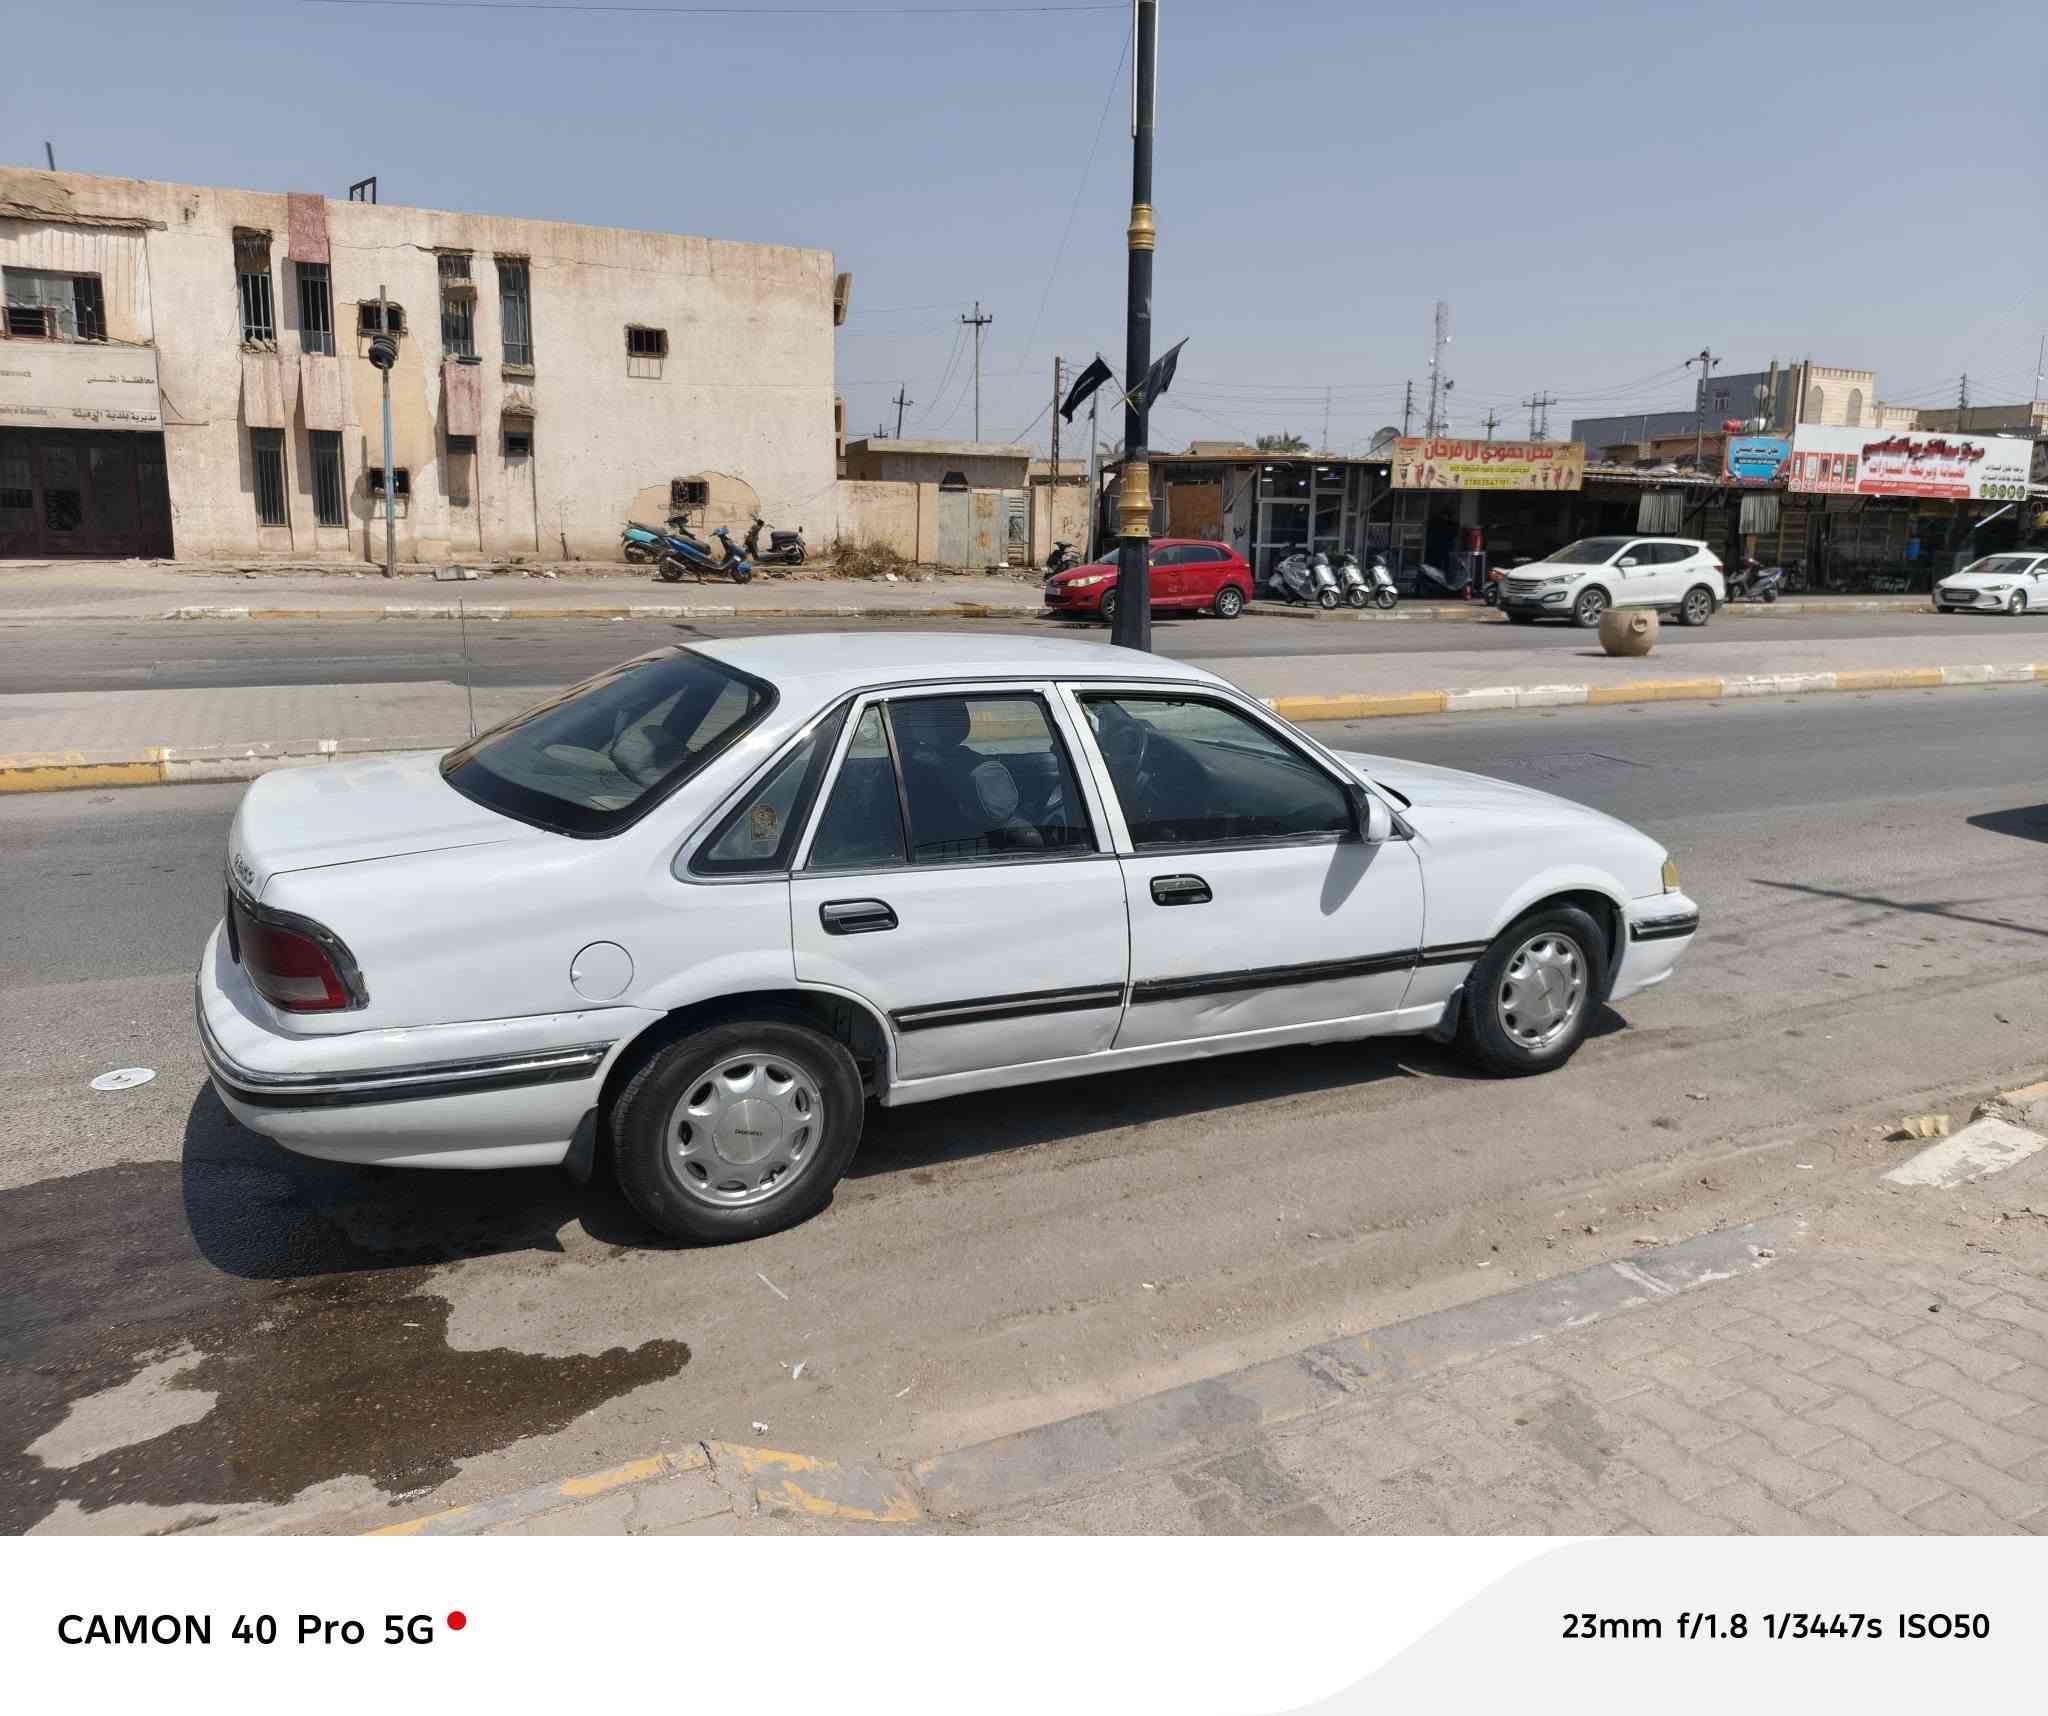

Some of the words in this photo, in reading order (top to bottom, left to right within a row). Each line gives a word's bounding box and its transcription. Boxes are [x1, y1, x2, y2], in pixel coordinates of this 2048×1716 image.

[1424, 441, 1463, 460] فرحان
[1481, 446, 1524, 464] حمودي
[1527, 446, 1553, 462] محل
